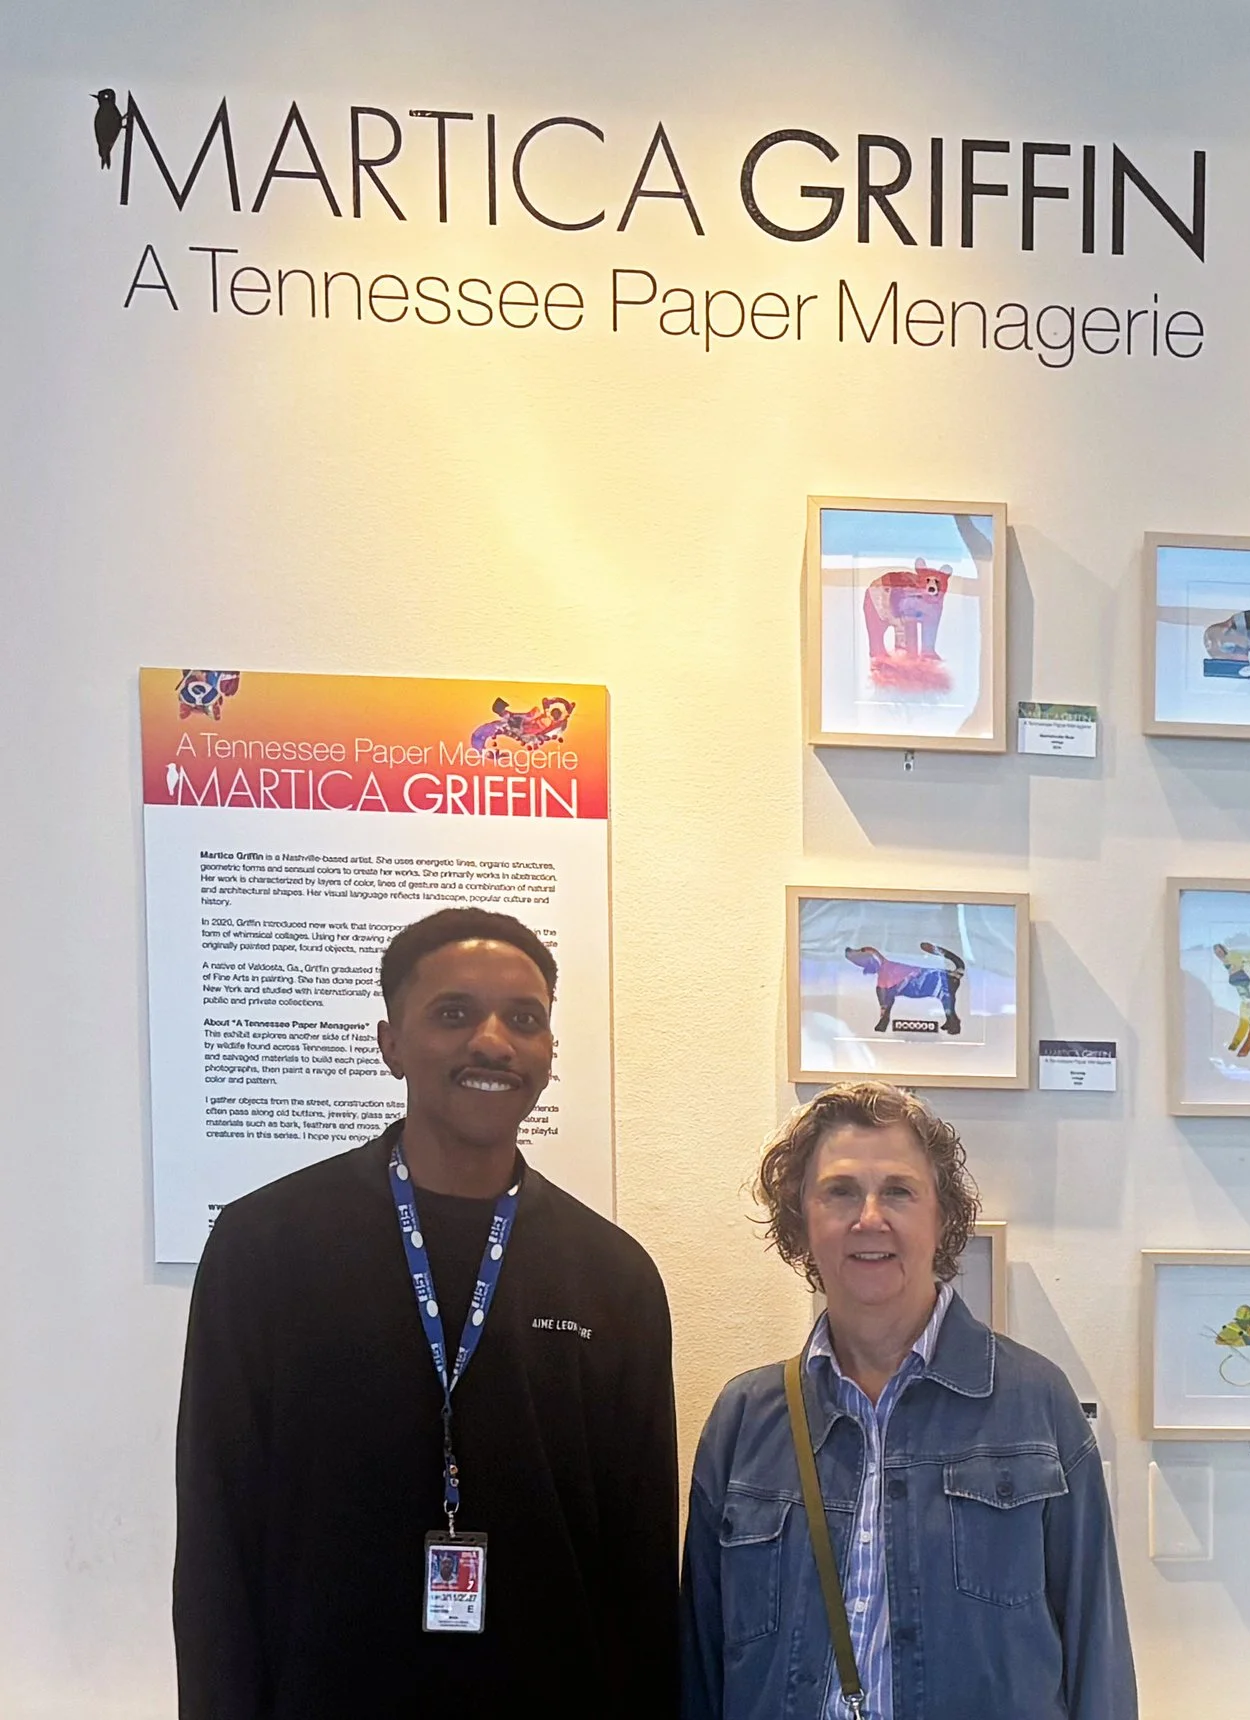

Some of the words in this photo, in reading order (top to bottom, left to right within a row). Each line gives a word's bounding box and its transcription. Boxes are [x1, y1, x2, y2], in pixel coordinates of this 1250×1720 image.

[119, 91, 705, 236] MARTICA
[740, 129, 1206, 263] GRIFFIN
[124, 244, 179, 310] A
[189, 247, 584, 331] Tennessee
[613, 269, 818, 352] Paper
[839, 279, 1204, 368] Menagerie
[176, 732, 196, 757] A
[200, 732, 346, 762] Tennessee
[354, 738, 433, 769] Paper
[439, 741, 578, 775] Menagerie
[178, 765, 390, 812] MARTICA
[403, 773, 577, 818] GRIFFIN
[532, 1318, 554, 1329] AIME
